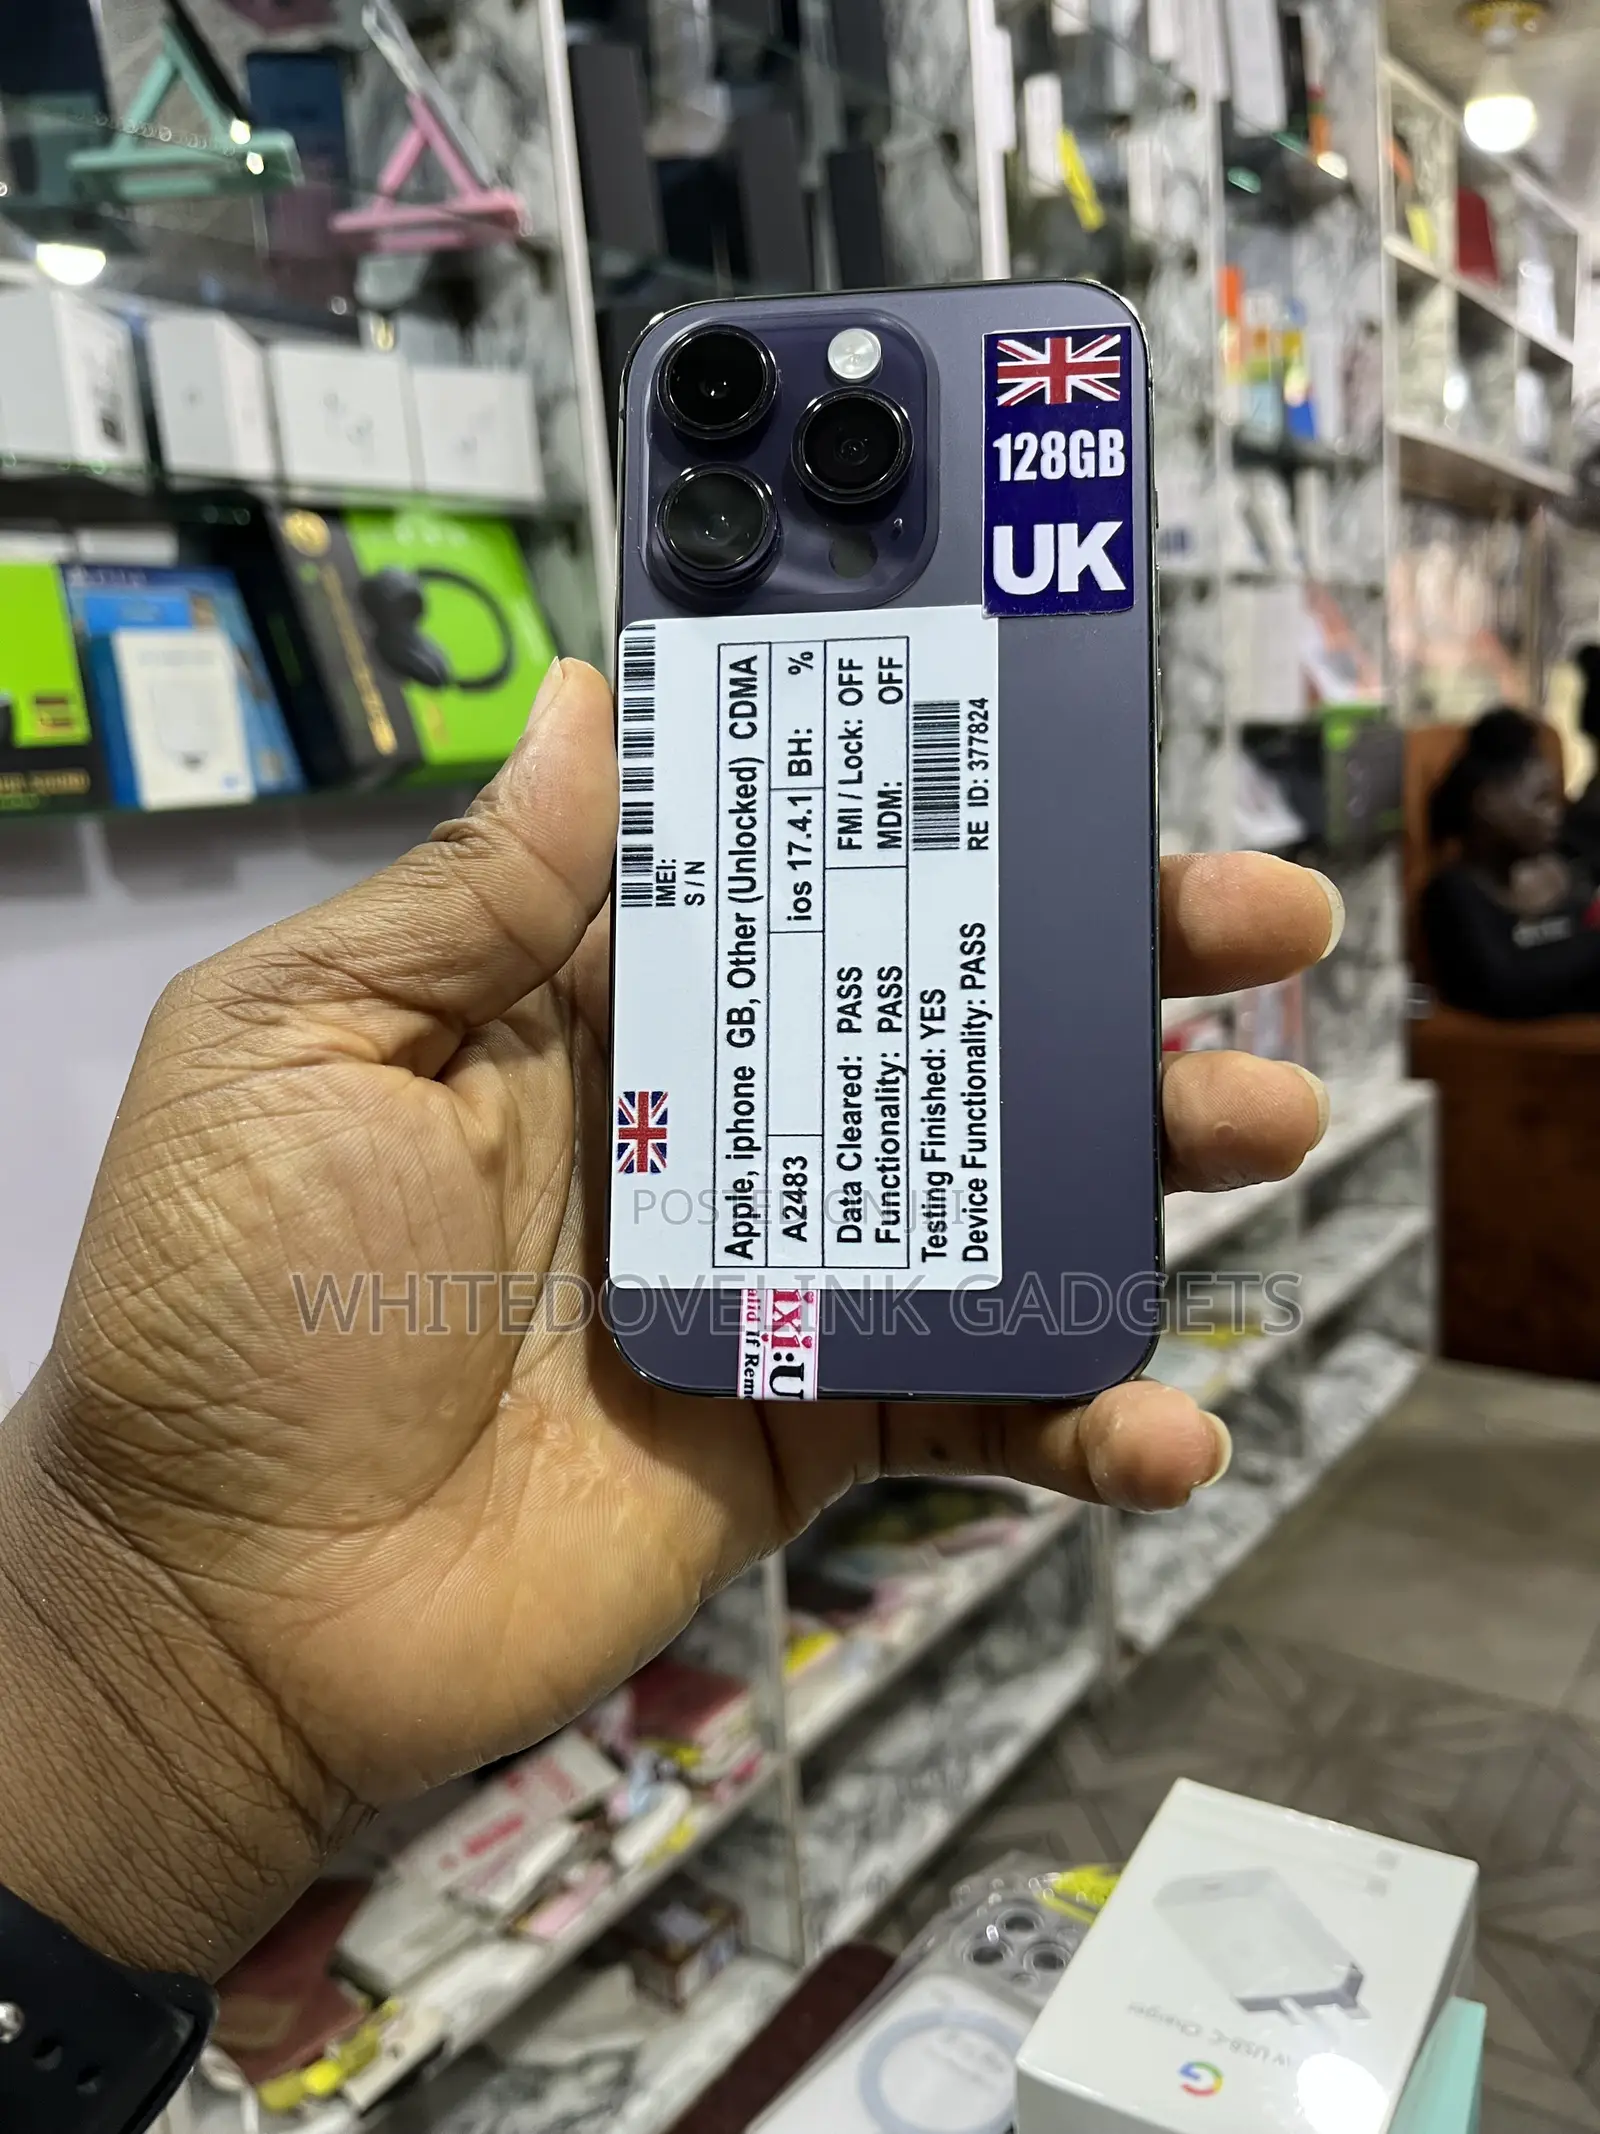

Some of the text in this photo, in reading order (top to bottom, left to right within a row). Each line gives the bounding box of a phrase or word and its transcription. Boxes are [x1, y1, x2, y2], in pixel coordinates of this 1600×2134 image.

[992, 429, 1126, 482] 128GB
[992, 520, 1127, 595] UK
[787, 651, 814, 777] BH: %
[837, 657, 864, 851] FMI / Lock: OFF
[876, 656, 904, 850] MDM: OFF
[967, 697, 989, 851] RE ID: 377824
[655, 858, 677, 907] IMEI:
[786, 795, 813, 921] ios 17.4.1
[723, 655, 765, 1261] Apple, iphone GB, Other (Unlocked) CDMA
[836, 966, 863, 1244] Data Cleared: PASS
[874, 965, 907, 1244] Functionality: PASS
[919, 988, 954, 1264] Testing Finished: YES
[959, 922, 993, 1262] Device Functionality: PASS
[781, 1155, 808, 1243] A2483
[746, 1331, 761, 1347] If
